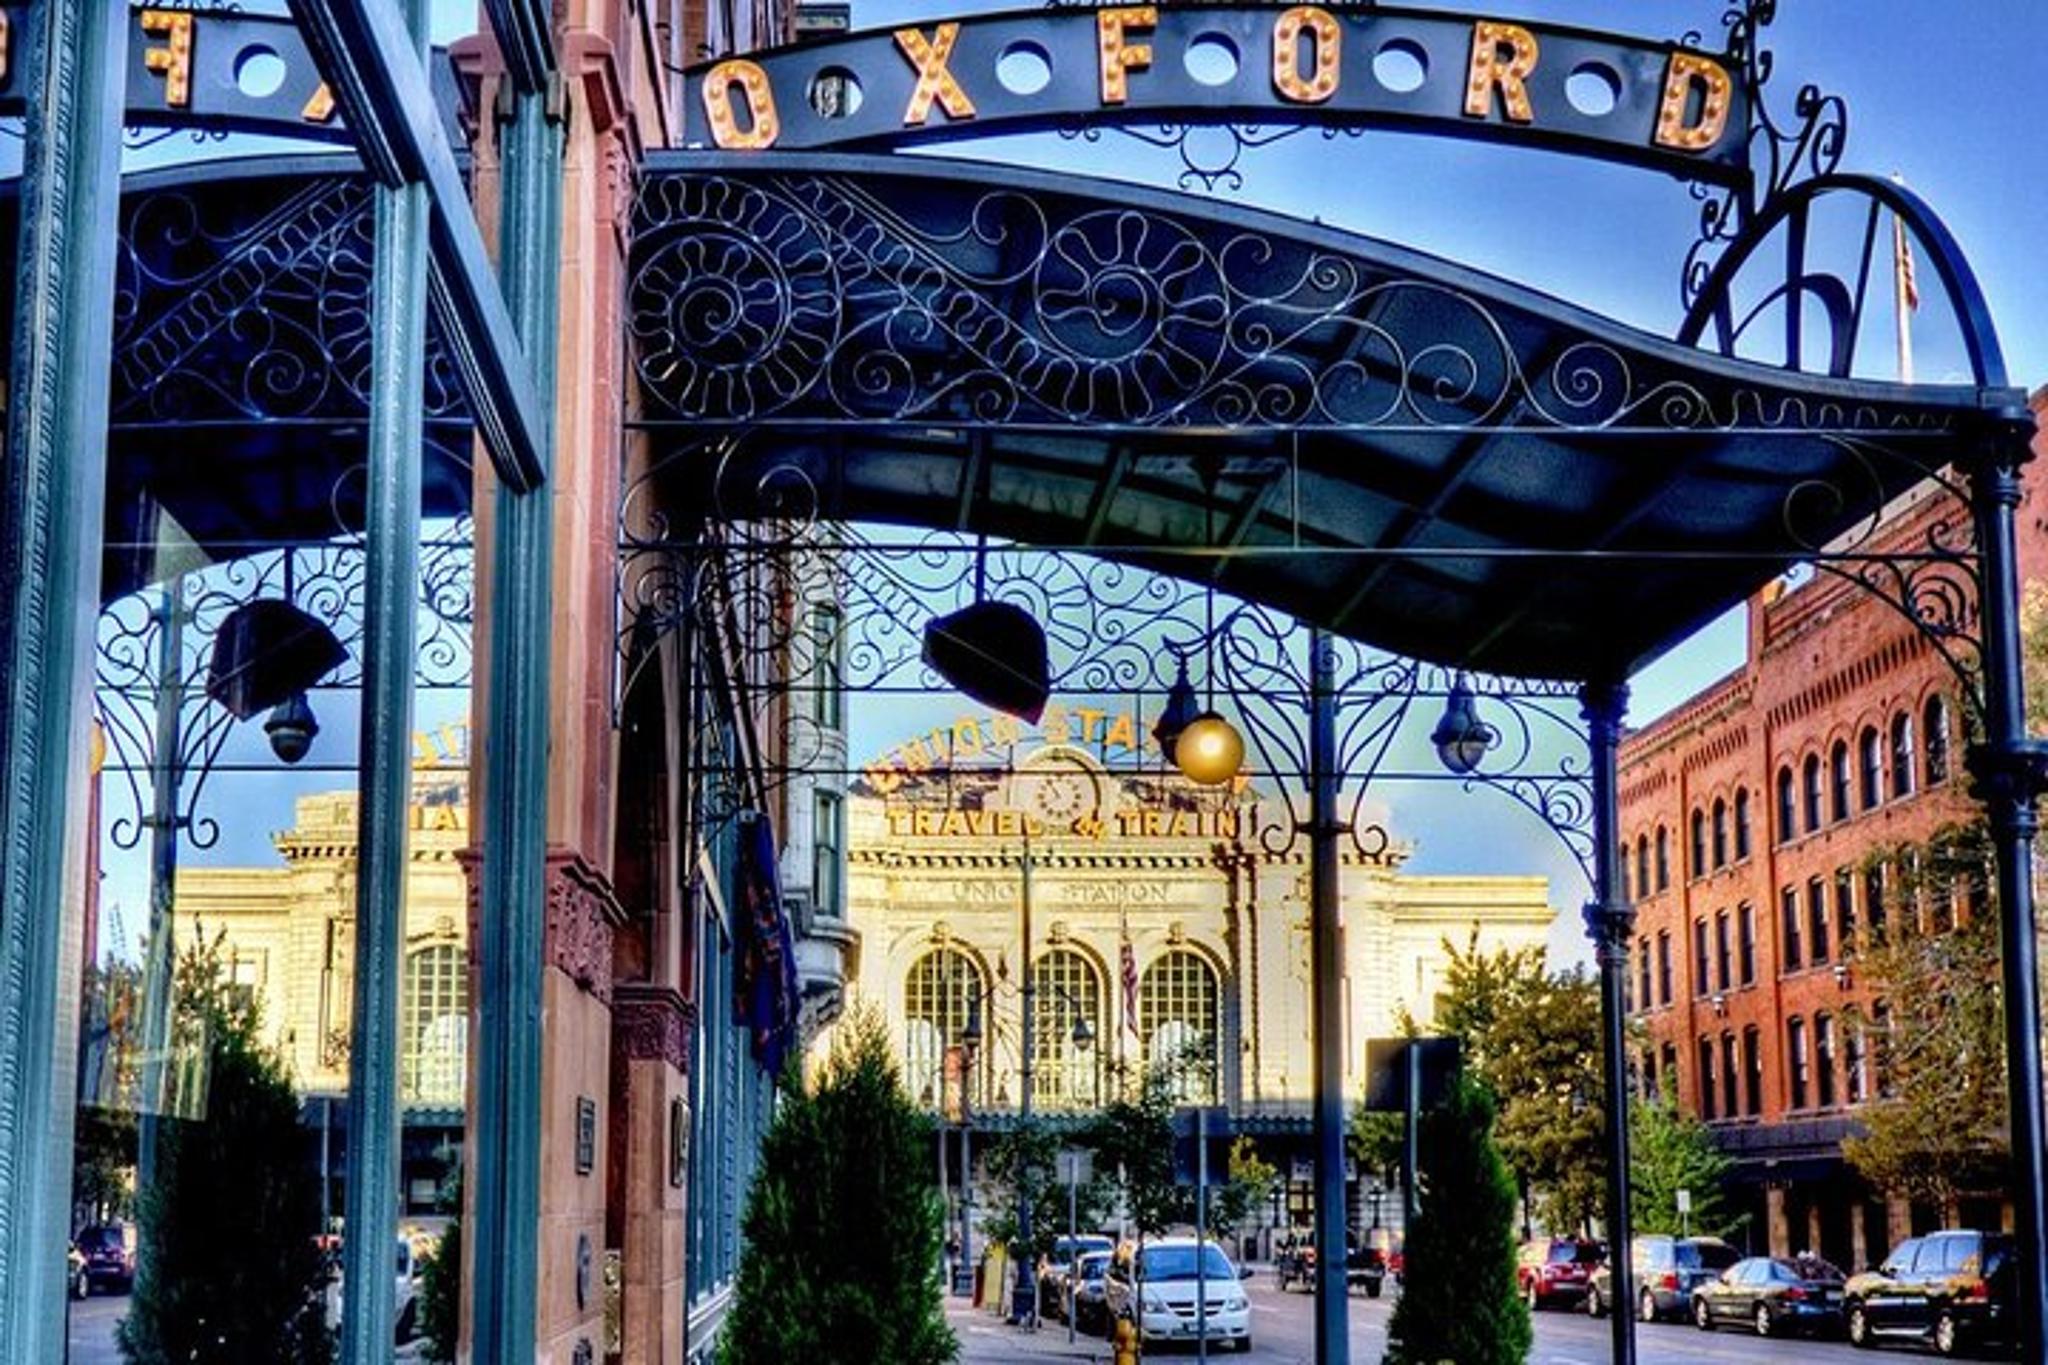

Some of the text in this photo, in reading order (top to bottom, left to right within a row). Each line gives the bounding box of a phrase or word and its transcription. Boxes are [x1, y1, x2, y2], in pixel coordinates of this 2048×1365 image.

[700, 7, 1732, 150] OXFORD
[864, 714, 1020, 795] UNION
[886, 809, 1043, 836] TRAVEL
[1115, 809, 1239, 837] TRAIN
[951, 881, 1017, 902] UNIO
